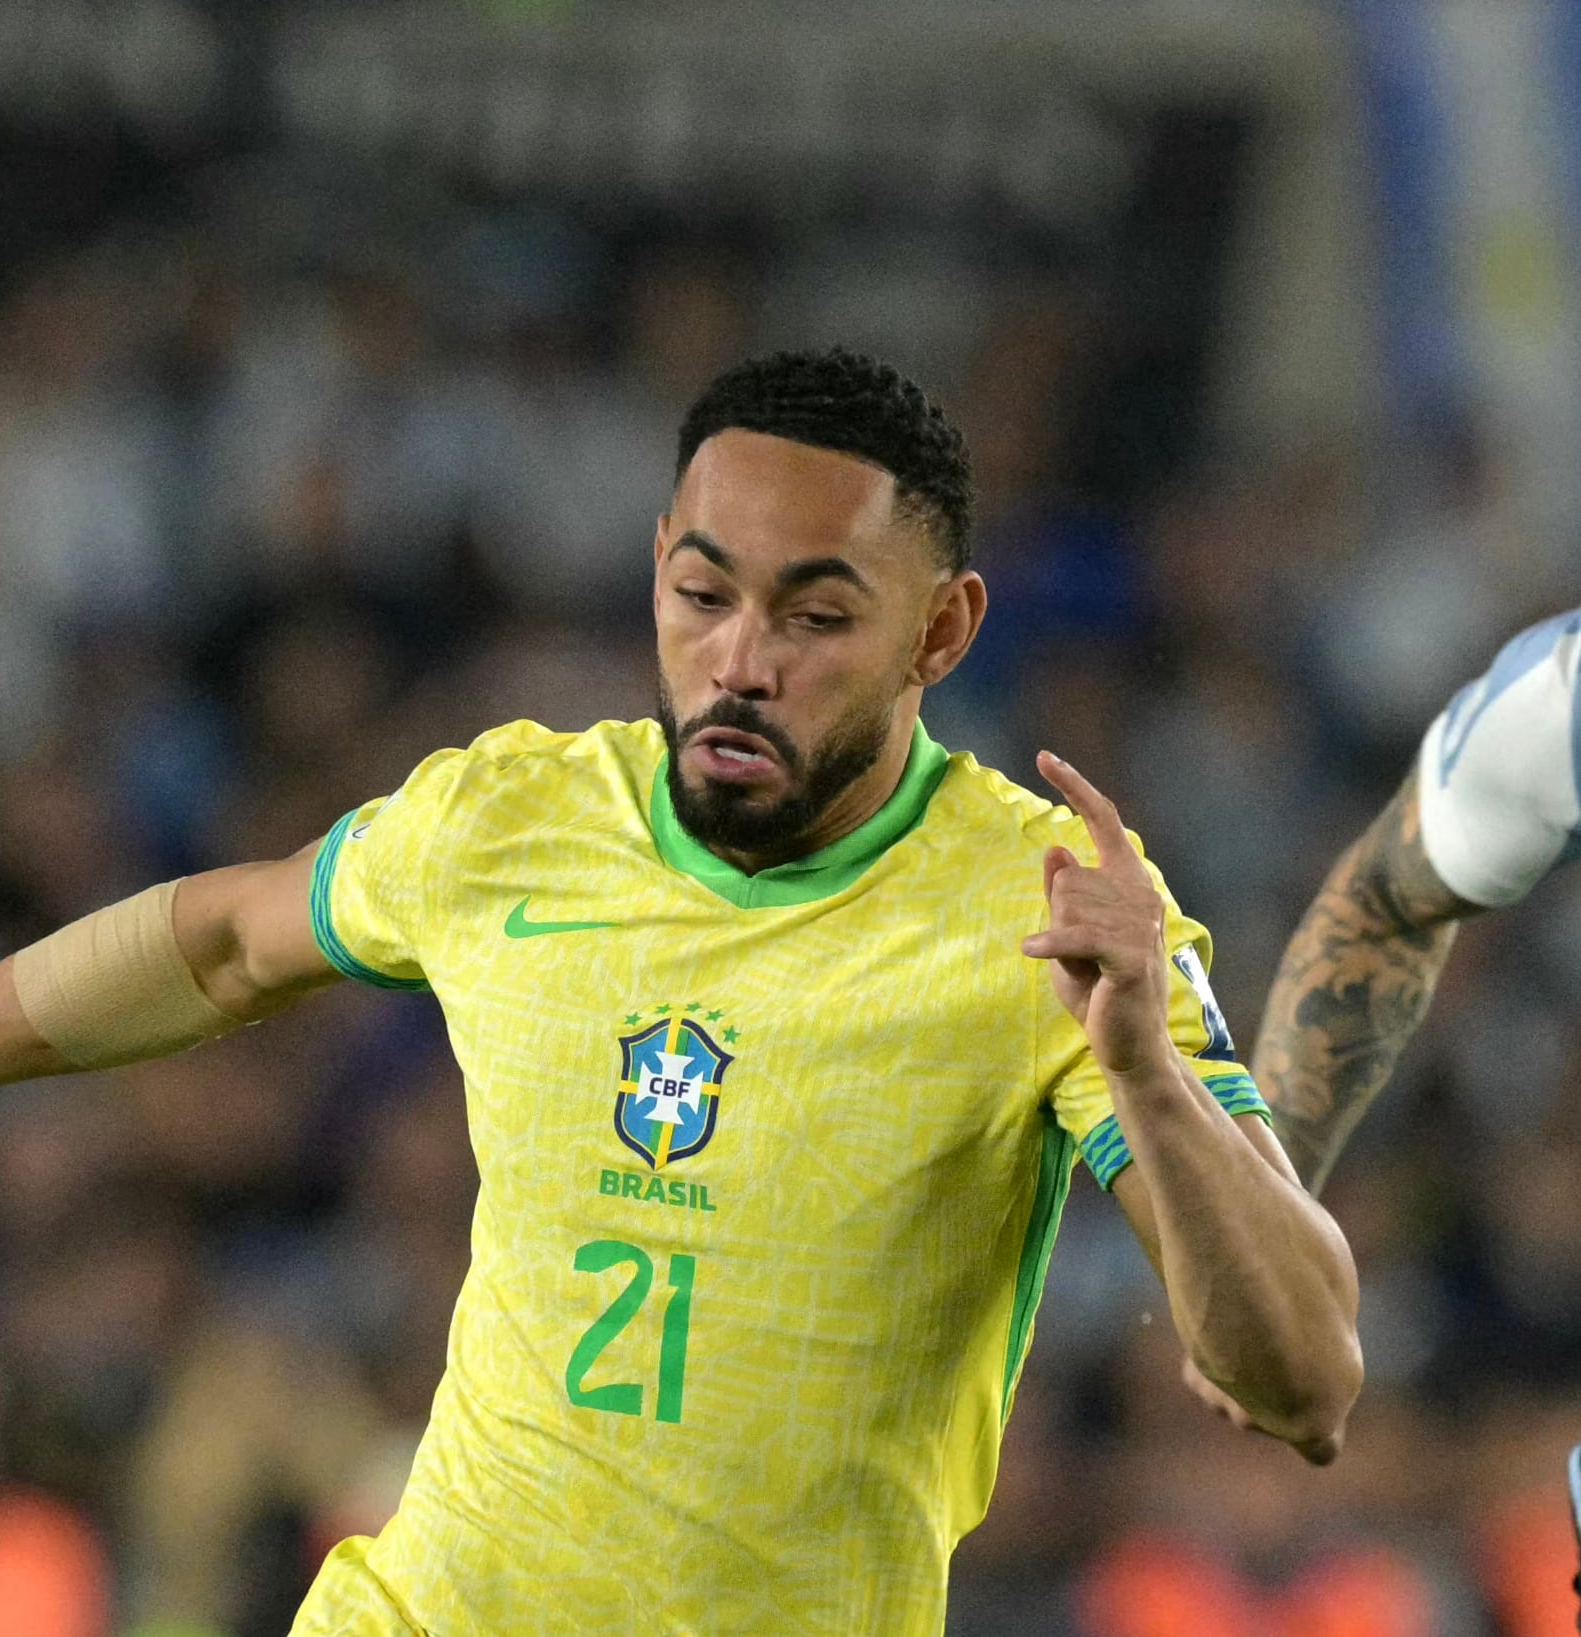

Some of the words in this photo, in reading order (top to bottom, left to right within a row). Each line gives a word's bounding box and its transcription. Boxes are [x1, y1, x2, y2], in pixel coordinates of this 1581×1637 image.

[648, 1077, 691, 1099] CBF
[598, 1168, 717, 1212] BRASIL
[565, 1239, 696, 1424] 21
